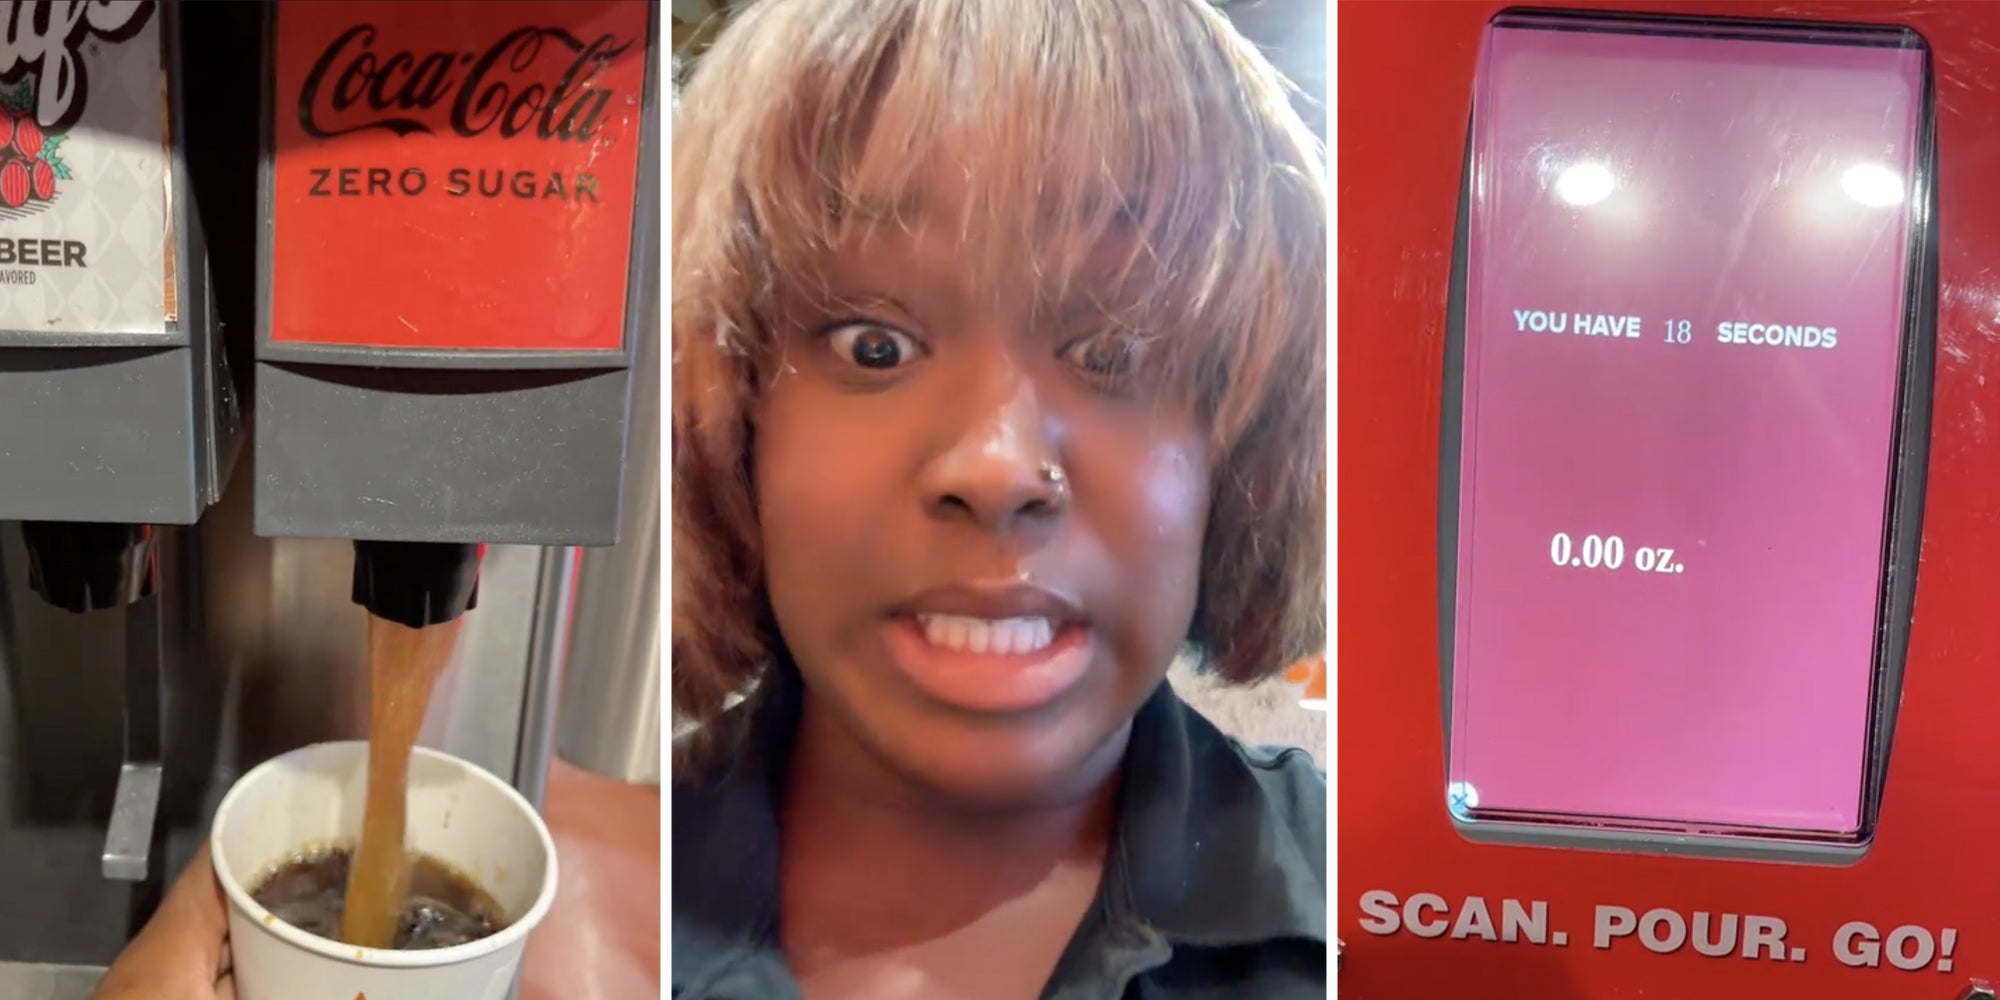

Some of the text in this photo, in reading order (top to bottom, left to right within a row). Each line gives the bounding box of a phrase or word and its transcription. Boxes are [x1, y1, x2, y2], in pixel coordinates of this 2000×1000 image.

[298, 24, 635, 141] Coca-Cola
[309, 168, 600, 203] ZERO SUGAR
[0, 238, 87, 268] BEER
[1513, 309, 1838, 349] YOU HAVE 18 SECONDS
[1550, 532, 1685, 574] 0.00 oz.
[1358, 890, 1958, 973] SCAN. POUR. GO!
